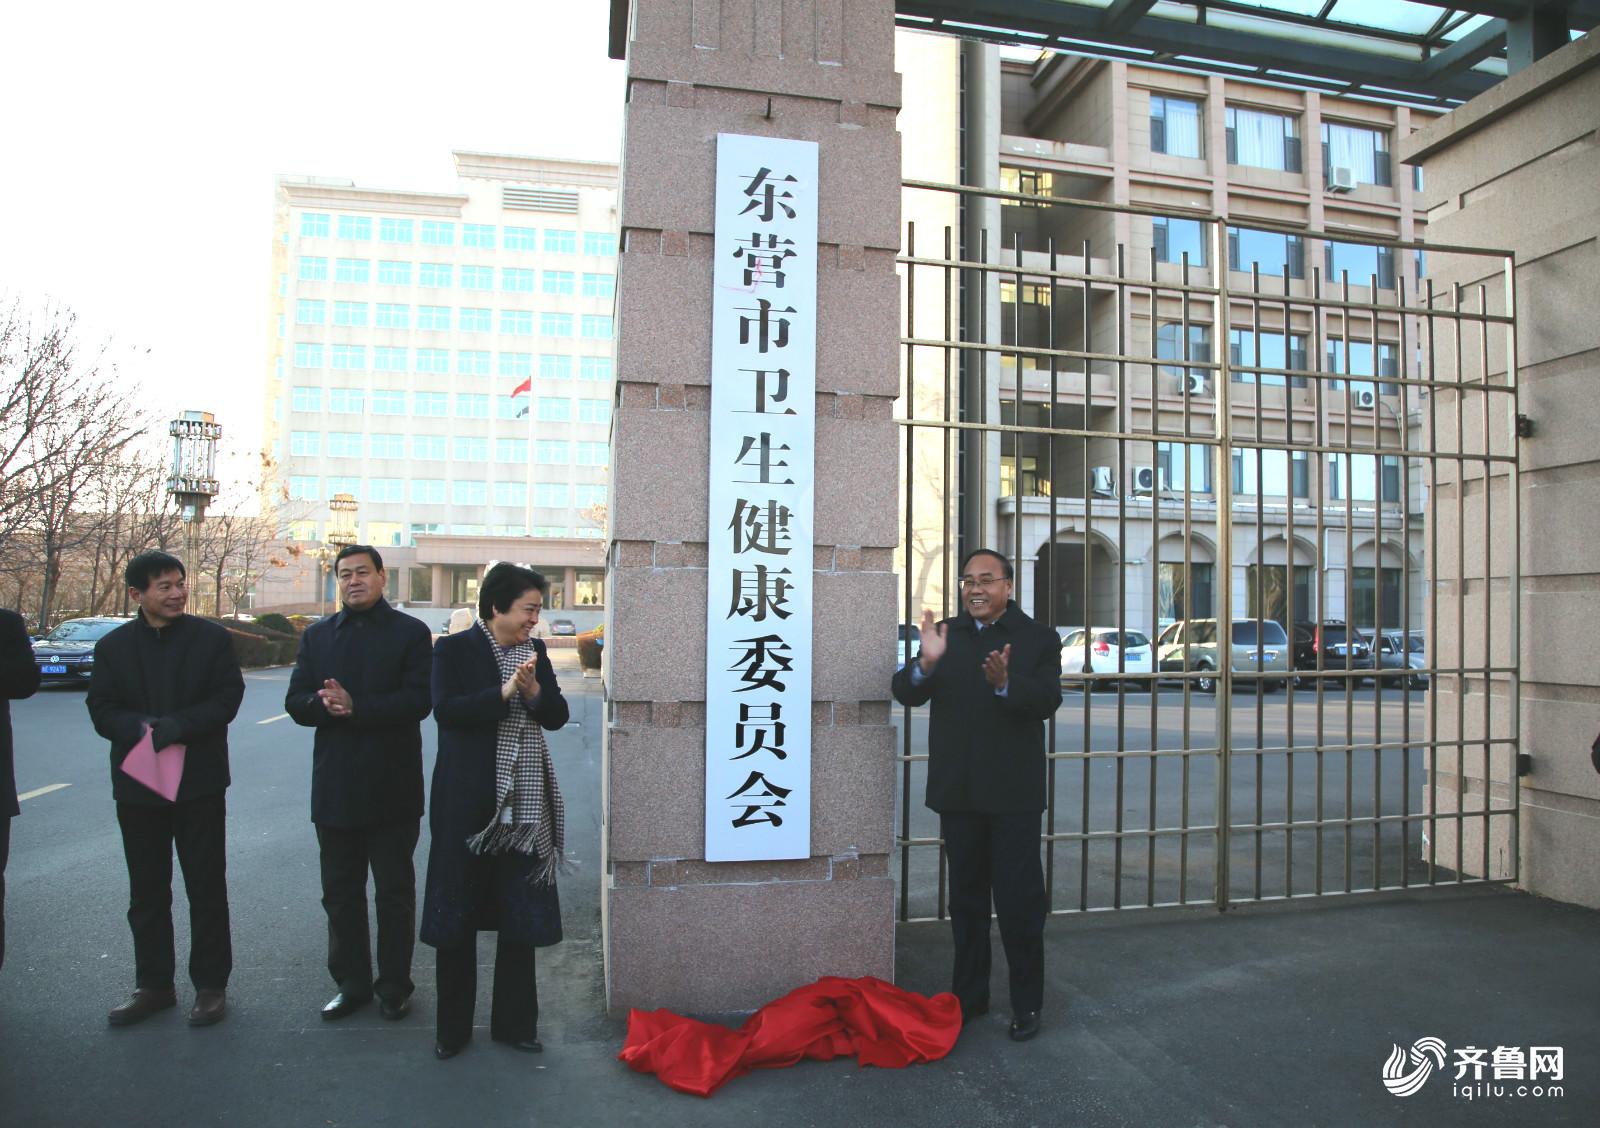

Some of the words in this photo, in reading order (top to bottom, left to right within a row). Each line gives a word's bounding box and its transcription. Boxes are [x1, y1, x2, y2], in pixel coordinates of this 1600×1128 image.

[726, 168, 797, 828] 东营市卫生健康委员会
